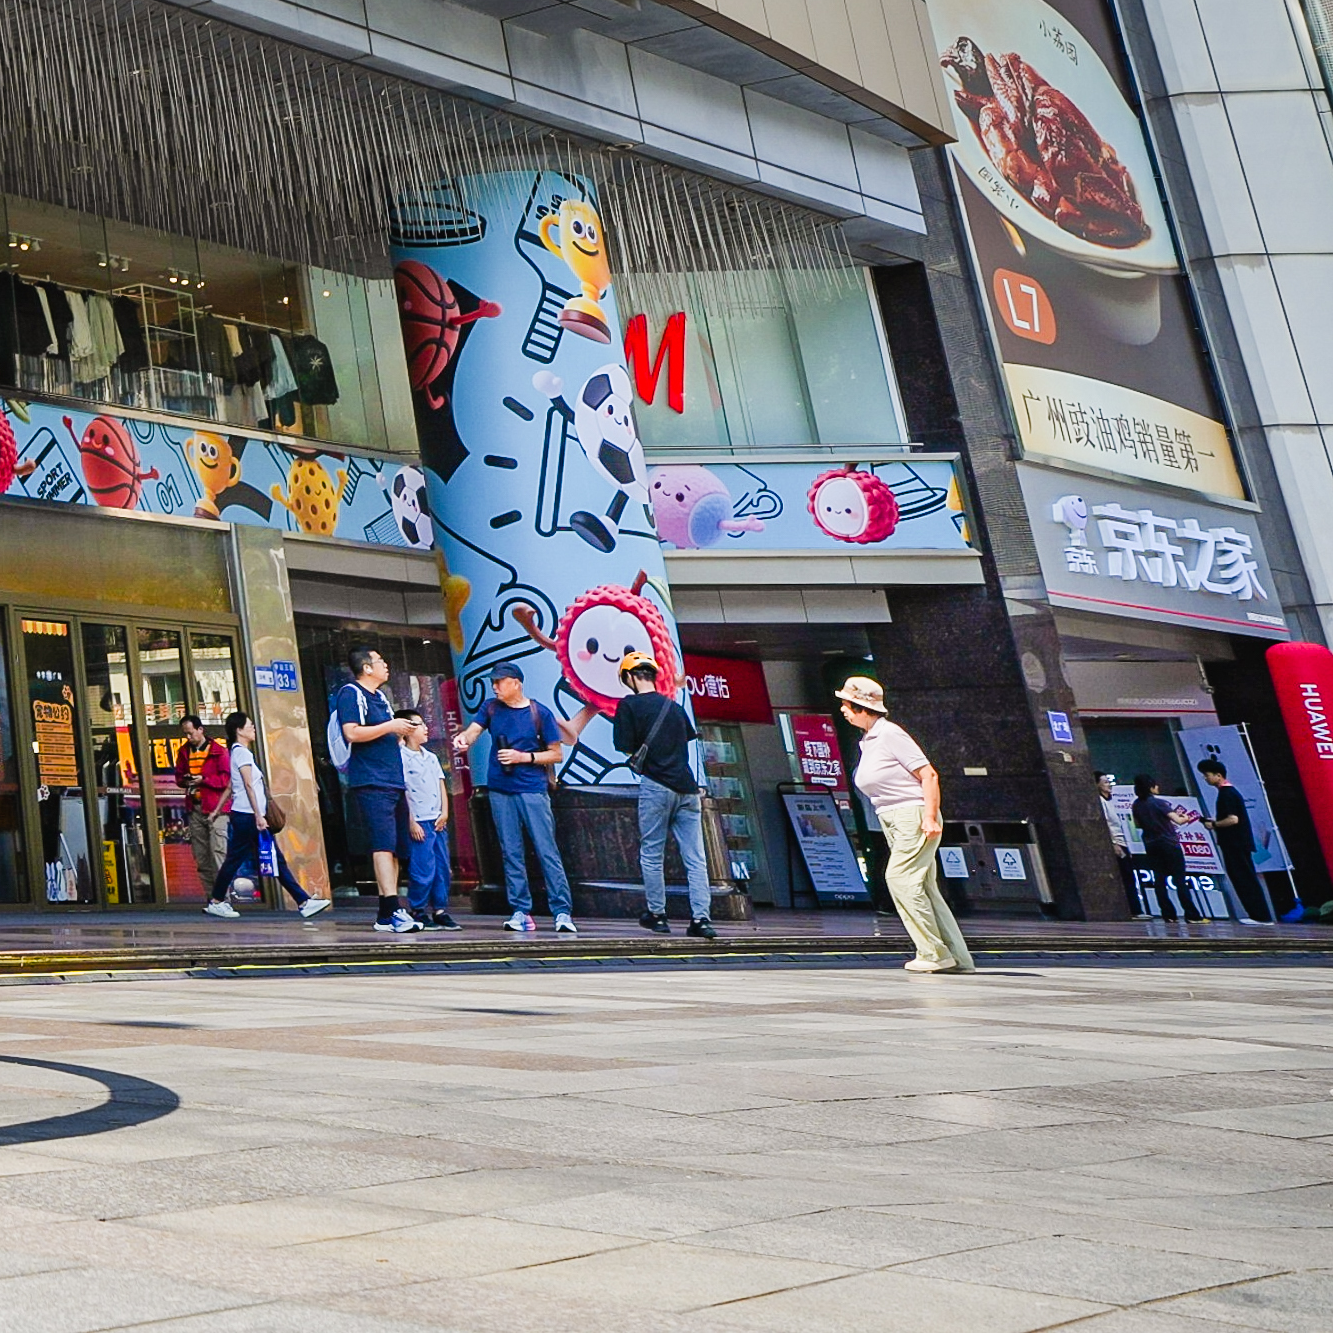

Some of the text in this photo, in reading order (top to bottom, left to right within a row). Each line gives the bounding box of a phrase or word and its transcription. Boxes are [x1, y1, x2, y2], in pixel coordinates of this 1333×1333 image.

[1002, 278, 1041, 333] L7
[1020, 388, 1216, 474] 广州豉油鸡销量第一
[36, 460, 64, 497] SPORT
[40, 471, 74, 500] UMMER
[1063, 546, 1100, 575] 京东
[1091, 502, 1269, 602] 京东之家
[1299, 683, 1333, 760] HUAWEI
